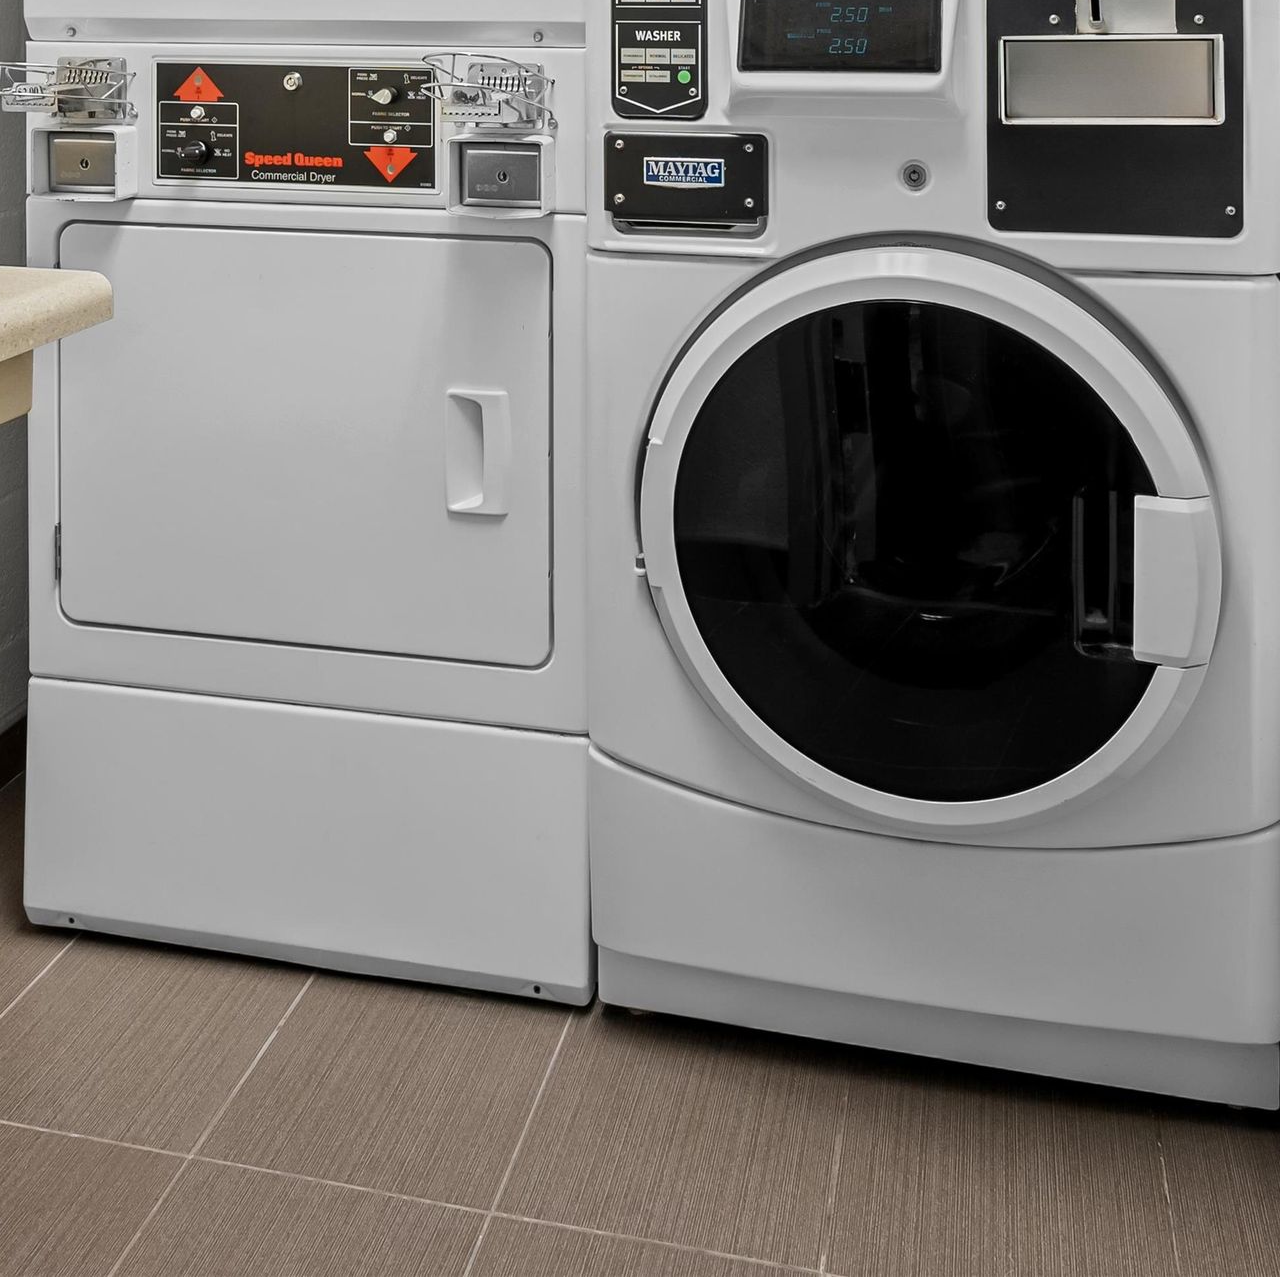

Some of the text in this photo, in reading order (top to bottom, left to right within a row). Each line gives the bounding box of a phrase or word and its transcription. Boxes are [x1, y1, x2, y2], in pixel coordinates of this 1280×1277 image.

[830, 7, 869, 22] 2.50
[635, 30, 681, 42] WASHER
[828, 38, 868, 54] 2.50
[244, 151, 343, 168] Speed Queen
[251, 169, 336, 184] Commercial Dryer
[647, 161, 720, 177] MAYTAG
[658, 175, 708, 183] COMMERCIAL
